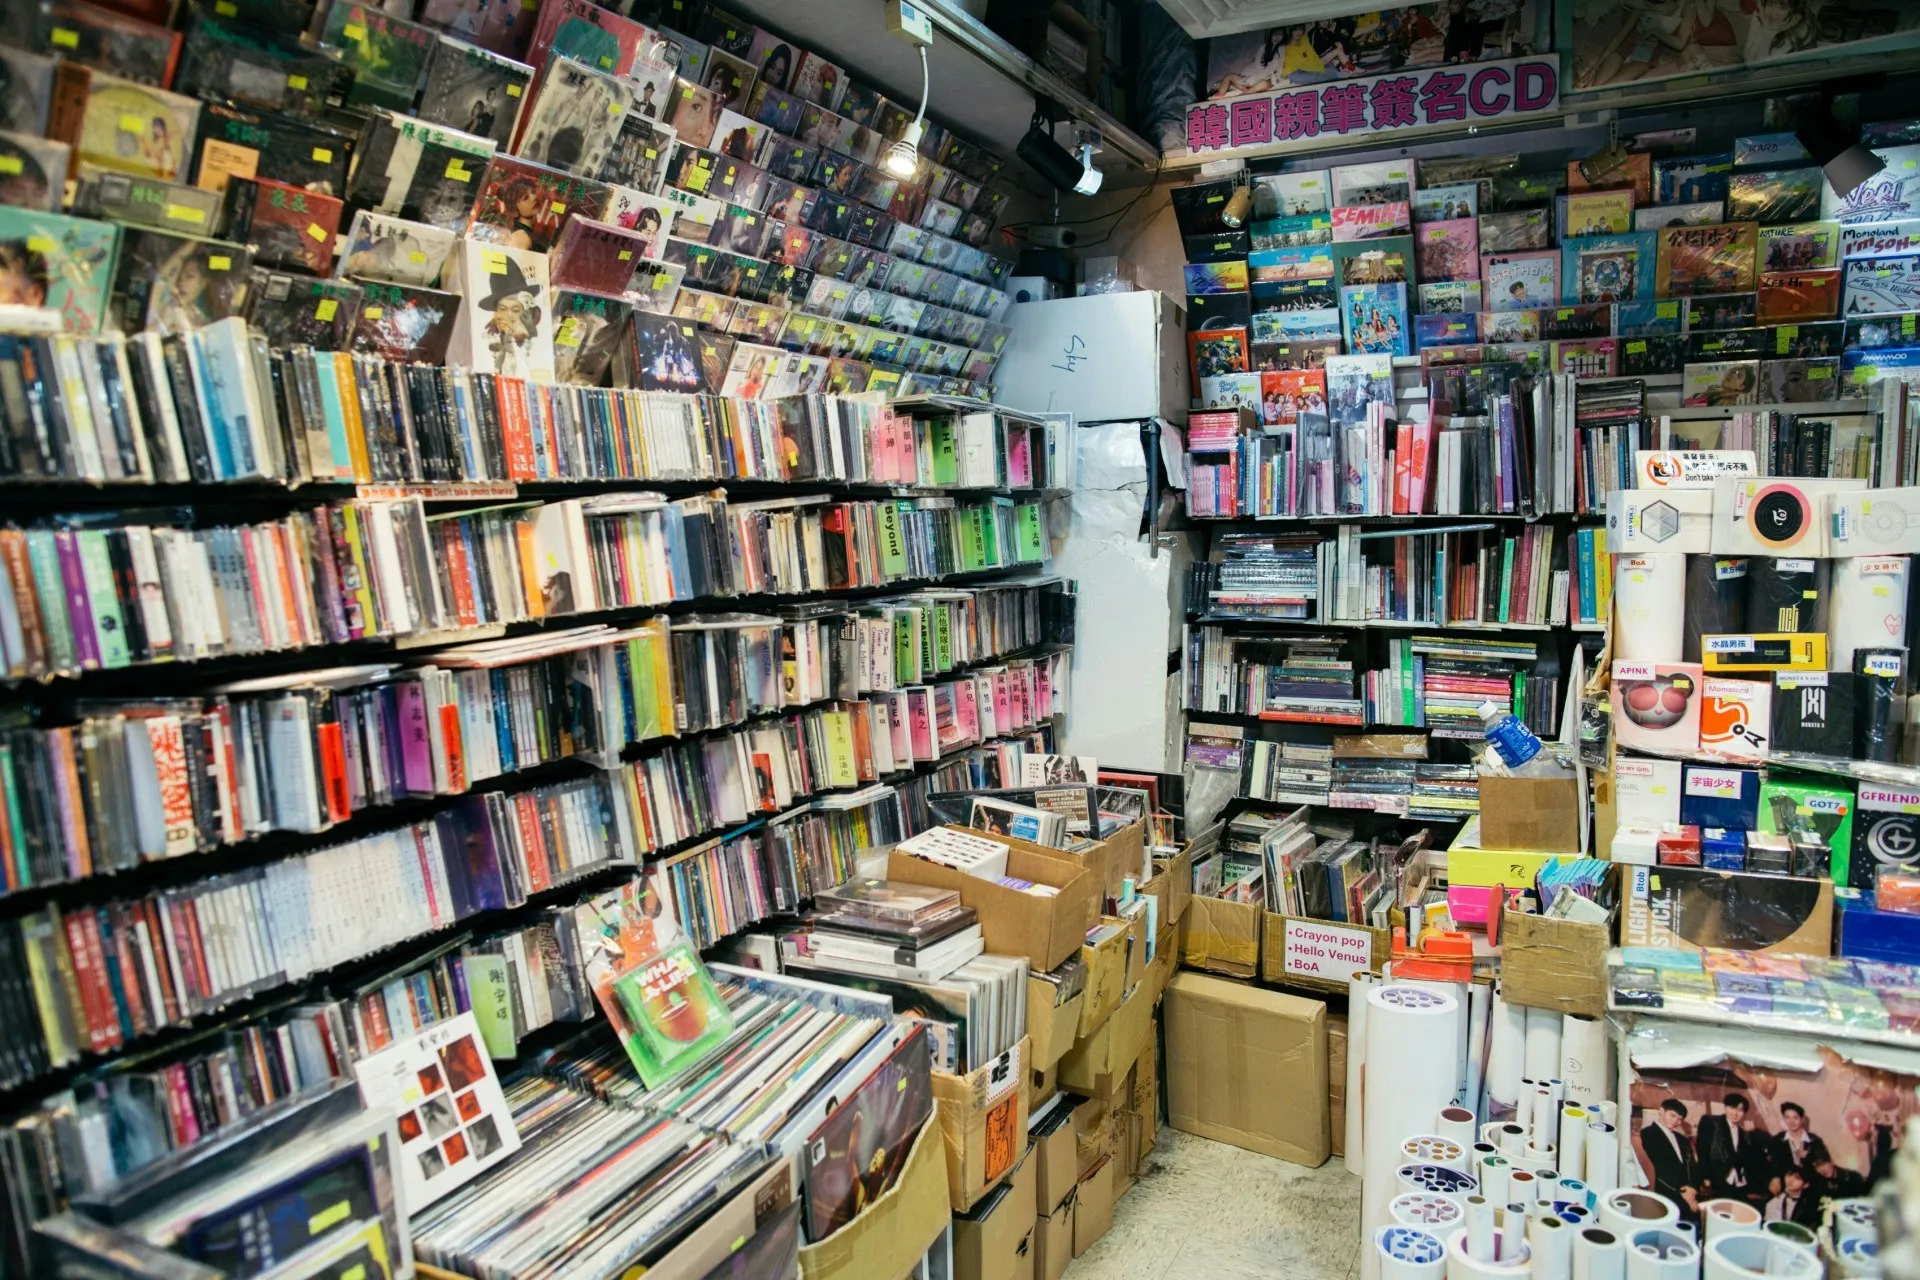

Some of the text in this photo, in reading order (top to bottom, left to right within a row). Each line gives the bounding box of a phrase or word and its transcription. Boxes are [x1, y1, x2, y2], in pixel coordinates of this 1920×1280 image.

[1187, 62, 1557, 153] 韓國親筆簽名CD
[1760, 228, 1794, 239] NATURE
[1843, 227, 1900, 240] Momoland
[1850, 262, 1904, 273] Momoland
[1685, 473, 1714, 482] Don't take
[886, 506, 900, 557] Beyond
[1711, 639, 1747, 648] 水晶男孩
[1620, 667, 1648, 675] APINK
[1692, 777, 1735, 788] 宇宙少女
[1861, 791, 1920, 804] GFRIEND
[1809, 800, 1840, 809] GOT7
[1636, 871, 1645, 892] Btob
[1295, 928, 1365, 949] Crayon pop
[1294, 944, 1367, 964] Hello Venus
[1294, 959, 1320, 972] BoA
